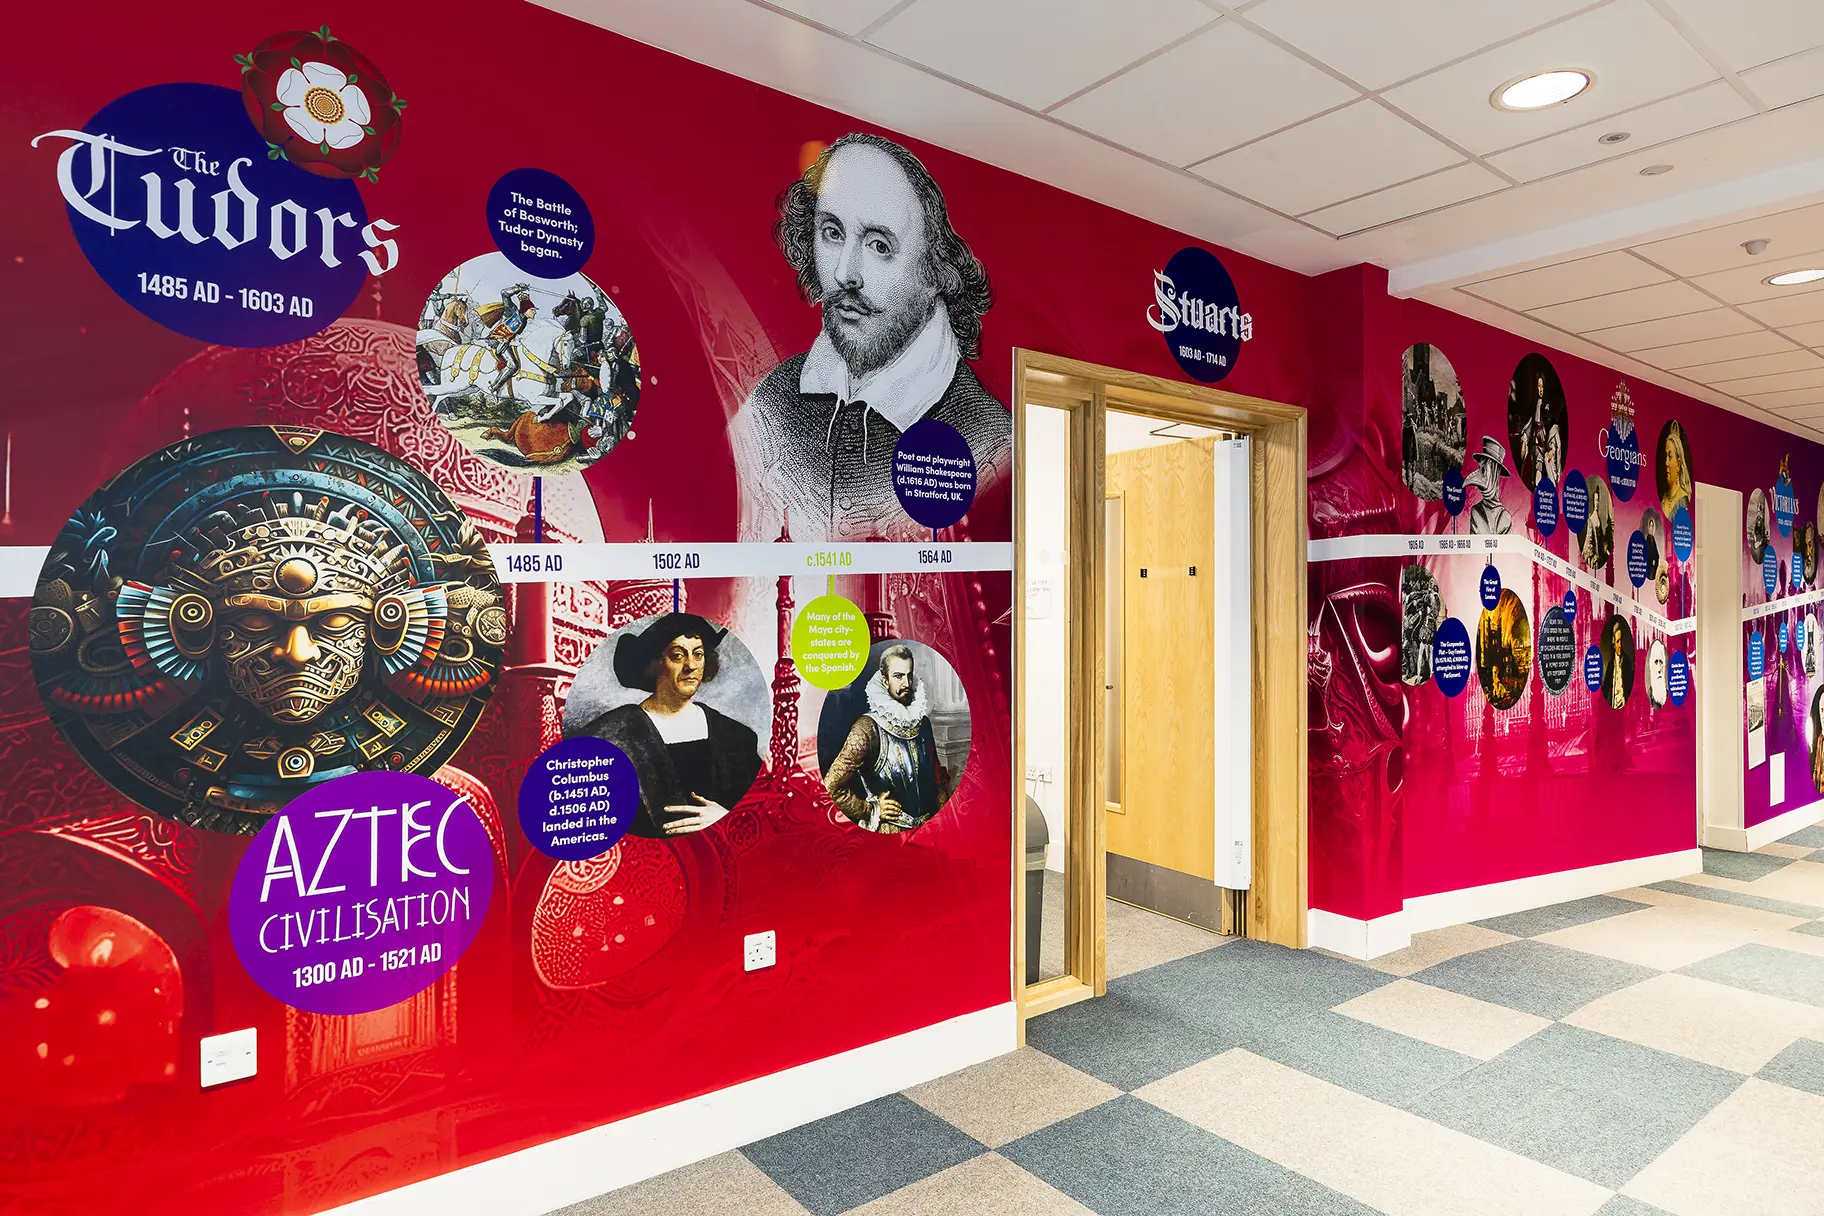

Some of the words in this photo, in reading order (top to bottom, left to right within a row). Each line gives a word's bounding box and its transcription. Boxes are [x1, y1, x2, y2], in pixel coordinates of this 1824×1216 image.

[168, 147, 220, 176] The
[31, 129, 400, 276] Tudors
[510, 191, 533, 206] The
[536, 198, 572, 216] Battle
[504, 208, 517, 218] of
[519, 209, 579, 234] Bosworth;
[498, 220, 535, 238] Tudor
[536, 228, 584, 251] Dynasty
[521, 240, 562, 259] began.
[137, 272, 188, 299] 1485
[193, 280, 220, 303] AD
[238, 288, 284, 314] 1603
[289, 296, 313, 318] AD
[1146, 268, 1253, 342] Stuarts
[1179, 346, 1193, 359] 1603
[1194, 350, 1201, 361] AD
[1206, 352, 1218, 365] 1714
[1219, 356, 1227, 367] AD
[1598, 428, 1648, 471] Georgians
[898, 450, 915, 461] Poet
[916, 454, 931, 463] and
[932, 456, 971, 469] playwright
[896, 463, 924, 474] William
[925, 466, 972, 479] Shakespeare
[896, 475, 922, 486] (d.1616
[924, 478, 938, 489] AD)
[938, 481, 953, 489] was
[954, 481, 971, 491] born
[905, 488, 912, 497] in
[914, 489, 950, 501] Stratford,
[950, 492, 963, 501] UK.
[506, 555, 541, 572] 1485
[545, 555, 562, 572] AD
[652, 553, 681, 570] 1502
[684, 553, 700, 569] AD
[806, 552, 838, 567] c.1541
[839, 552, 852, 566] AD
[918, 550, 940, 564] 1564
[940, 550, 952, 564] AD
[807, 612, 830, 624] Many
[832, 612, 842, 621] of
[842, 612, 856, 621] the
[809, 625, 833, 636] Maya
[834, 625, 854, 636] city-
[810, 638, 836, 647] states
[802, 650, 848, 662] conquered
[850, 650, 860, 661] by
[805, 664, 820, 673] the
[821, 663, 857, 675] Spanish.
[546, 756, 615, 771] Christopher
[551, 771, 609, 786] Columbus
[548, 788, 588, 803] (b.1451
[590, 786, 610, 800] AD,
[549, 803, 587, 817] d.1506
[588, 800, 610, 813] AD)
[542, 817, 584, 832] landed
[586, 817, 596, 828] in
[598, 815, 618, 826] the
[550, 832, 609, 848] Americas.
[259, 796, 471, 903] AZTEC
[259, 886, 471, 954] CIVILISATION
[293, 962, 337, 989] 1300
[340, 957, 364, 980] AD
[379, 947, 416, 972] 1521
[422, 942, 443, 965] AD
